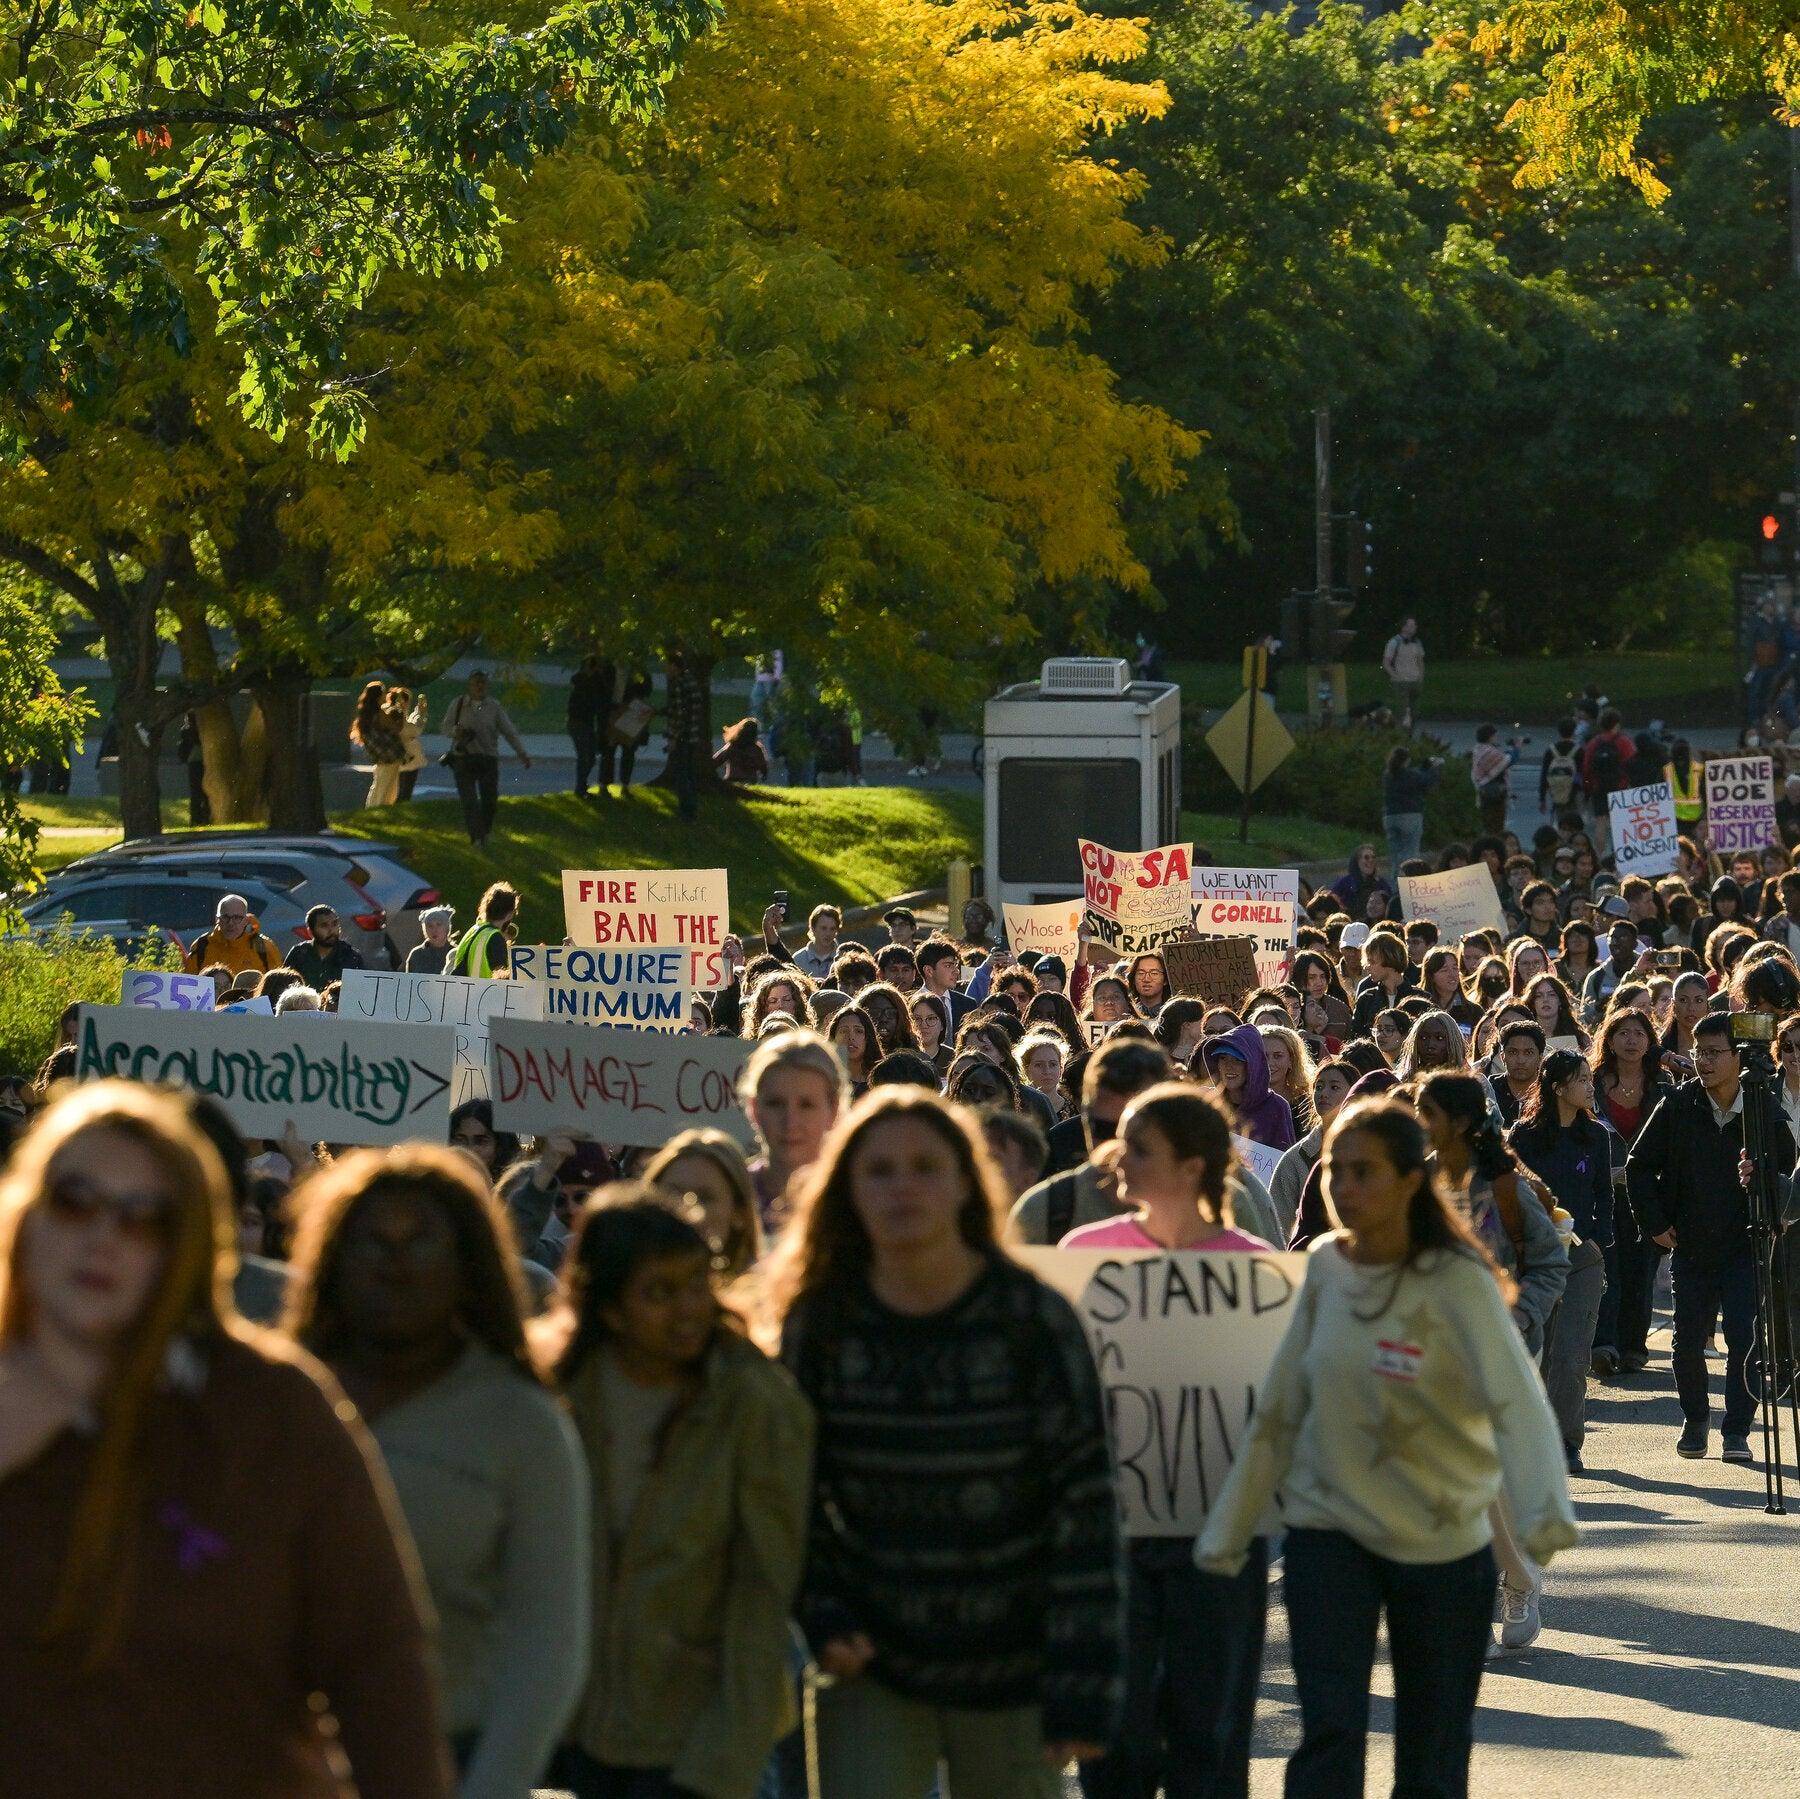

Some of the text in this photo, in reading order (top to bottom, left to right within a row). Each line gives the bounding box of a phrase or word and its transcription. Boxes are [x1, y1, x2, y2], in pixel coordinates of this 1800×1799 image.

[1708, 761, 1771, 782] JANE
[1712, 783, 1766, 802] DOE
[1628, 803, 1660, 823] IS
[1710, 804, 1774, 821] DESERVES
[1622, 817, 1670, 845] NOT
[1710, 821, 1774, 850] JUSTICE
[1615, 834, 1679, 863] CONSENT
[578, 880, 637, 904] FIRE
[1085, 874, 1122, 913] NOT
[1202, 873, 1278, 890] WE WANT
[594, 910, 720, 945] BAN THE
[1008, 915, 1063, 937] Whose
[1086, 909, 1123, 949] STOP
[1124, 915, 1189, 935] PROTECTING
[1166, 944, 1184, 965] AT
[1264, 938, 1289, 952] THE
[511, 947, 682, 985] REQUIRE
[1168, 962, 1225, 984] RAPISTS
[1228, 961, 1252, 977] ARE
[358, 975, 524, 1027] JUSTICE
[549, 987, 682, 1020] INIMUM
[496, 1043, 666, 1113] DAMAGE
[1088, 1255, 1294, 1323] STAND
